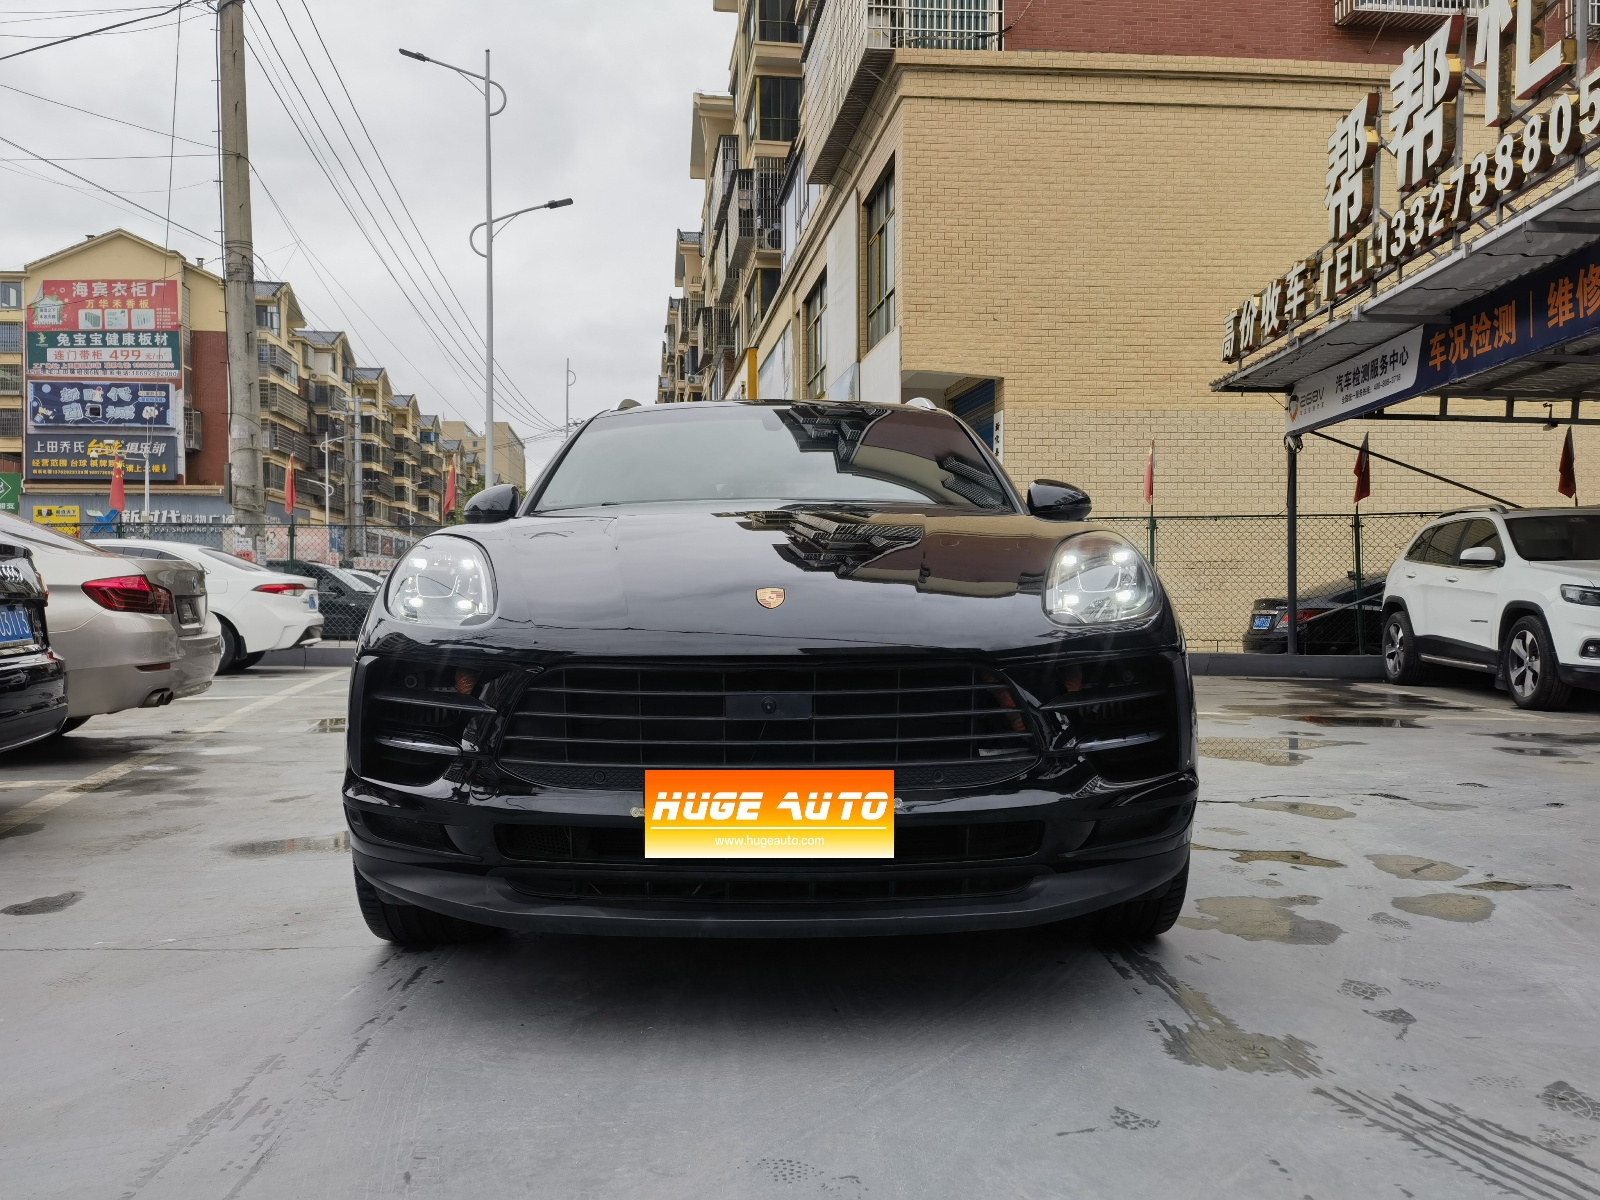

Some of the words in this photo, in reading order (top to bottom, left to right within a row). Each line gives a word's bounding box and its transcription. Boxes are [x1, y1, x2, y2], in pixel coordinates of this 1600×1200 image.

[72, 282, 167, 298] 海宾衣柜厂
[86, 299, 150, 309] 万华禾香板
[1221, 259, 1307, 361] 高价收车
[1429, 300, 1517, 372] 车况检测
[1547, 263, 1600, 328] 维修
[57, 332, 169, 347] 兔宝宝健康板材
[54, 350, 103, 361] 连门带柜
[109, 350, 142, 360] 499
[1335, 346, 1409, 394] 汽车检测服务中心
[32, 459, 68, 467] 经营范围
[70, 459, 87, 467] 台球
